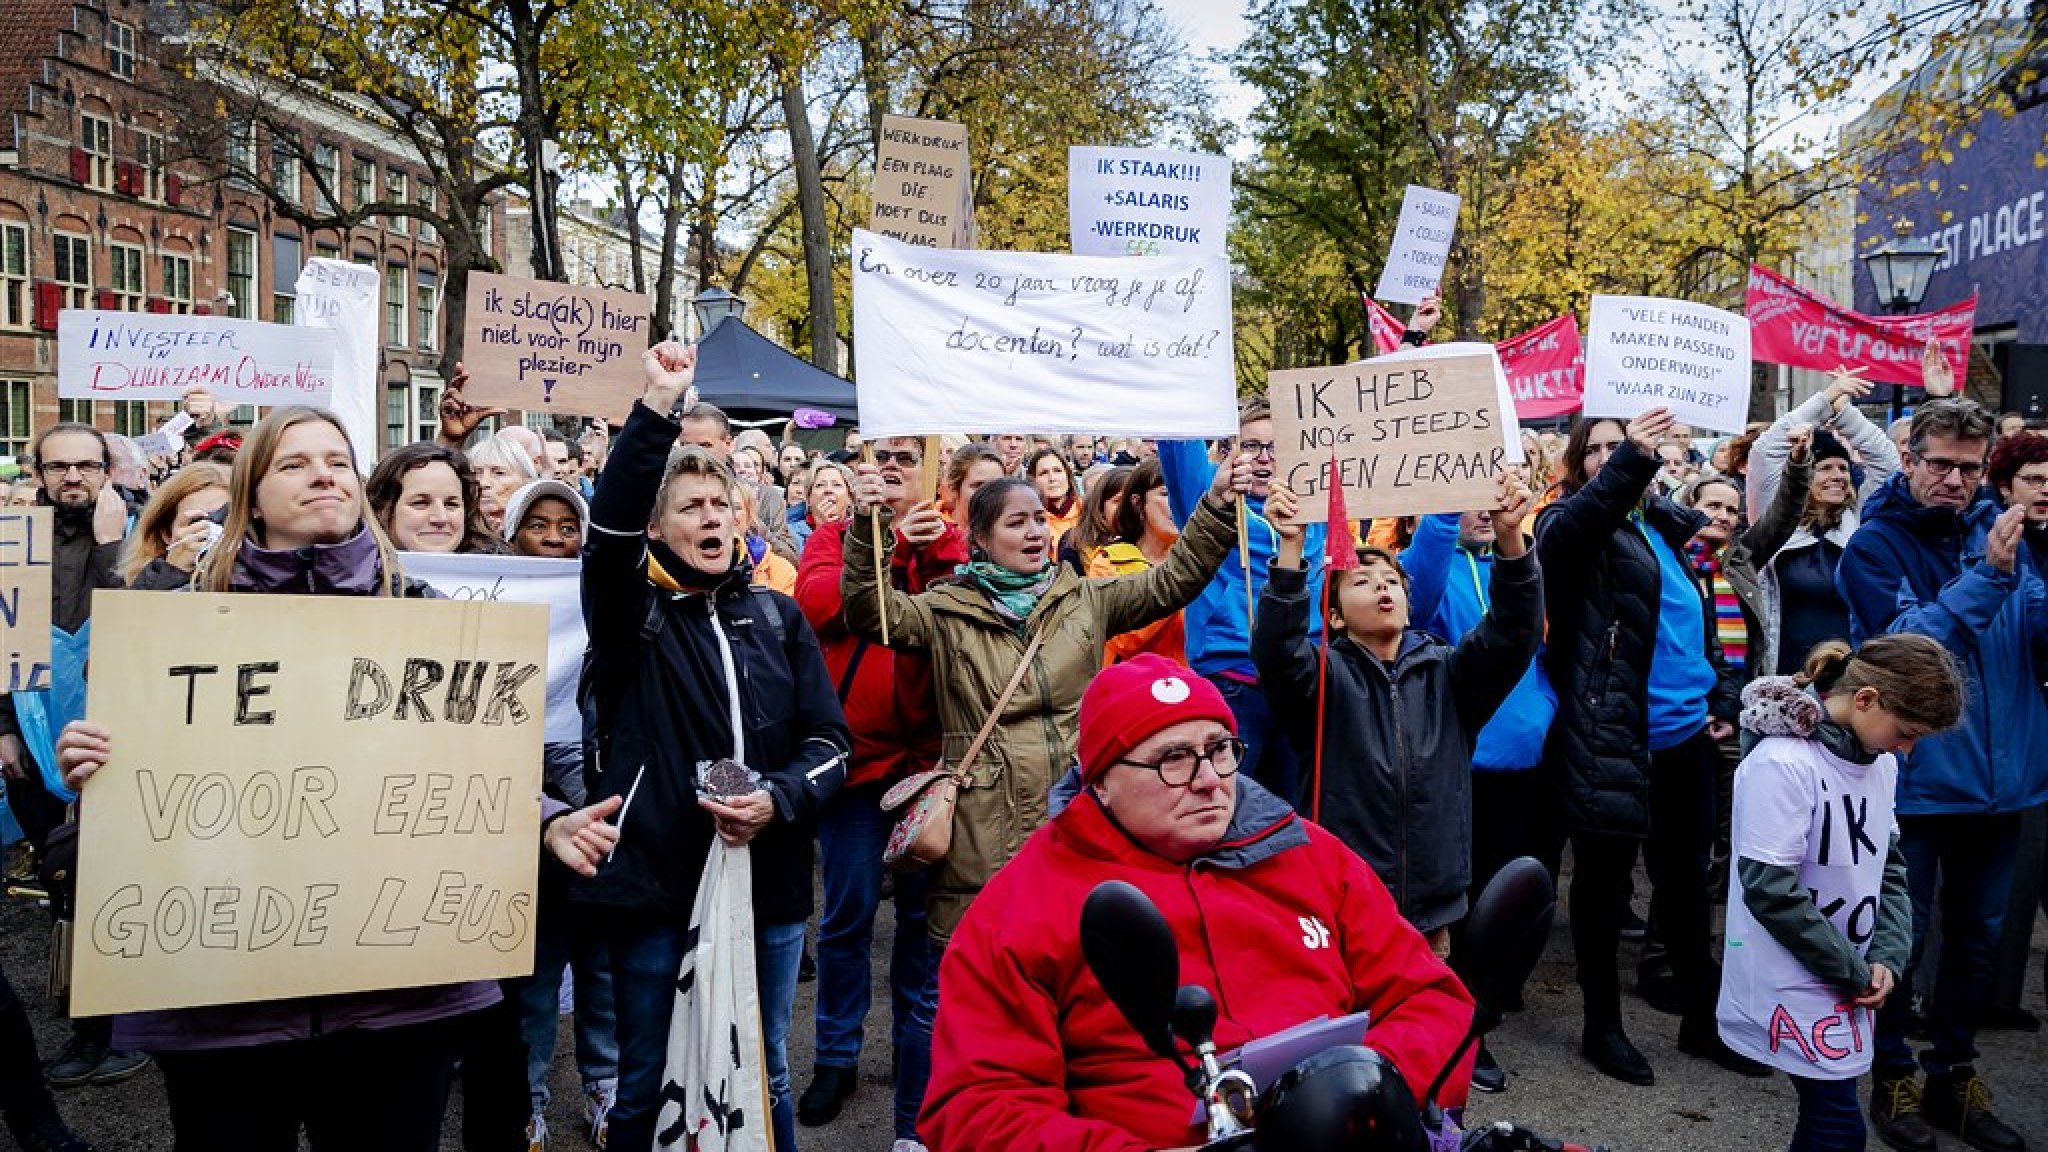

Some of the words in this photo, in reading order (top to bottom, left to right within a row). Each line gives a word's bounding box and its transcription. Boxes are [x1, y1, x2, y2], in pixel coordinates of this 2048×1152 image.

[1097, 159, 1115, 174] IK
[1120, 159, 1201, 182] STAAK!!!
[876, 202, 912, 218] MOET
[918, 210, 947, 226] DUS
[1104, 190, 1189, 211] +SALARIS
[1090, 220, 1201, 244] -WERKDRUK
[1970, 190, 2045, 260] PLACE
[860, 248, 893, 275] En
[904, 267, 959, 287] over
[975, 271, 1001, 289] 20
[1004, 273, 1057, 306] jaar
[485, 288, 502, 313] ik
[511, 292, 595, 339] sta(ak)
[602, 302, 647, 332] hier
[1671, 313, 1729, 336] HANDEN
[482, 324, 522, 345] niet
[527, 332, 570, 350] voor
[577, 337, 623, 363] mijn
[946, 316, 1083, 364] docenten?
[1097, 334, 1134, 358] wat
[1144, 341, 1161, 359] is
[1165, 330, 1221, 359] dat?
[1610, 331, 1669, 347] MAKEN
[1674, 336, 1735, 361] PASSEND
[519, 352, 593, 381] plezier
[1295, 378, 1336, 419] IK
[1356, 369, 1435, 412] HEB
[1668, 385, 1697, 403] ZIJN
[1300, 424, 1355, 451] NOG
[1372, 408, 1491, 441] STEEDS
[1287, 453, 1379, 497] GEEN
[1394, 446, 1505, 488] LERAAR
[169, 661, 281, 726] TE
[344, 656, 540, 726] DRUK
[135, 765, 341, 843] VOOR
[374, 773, 513, 838] EEN
[91, 883, 340, 959] GOEDE
[355, 870, 531, 953] LEUS
